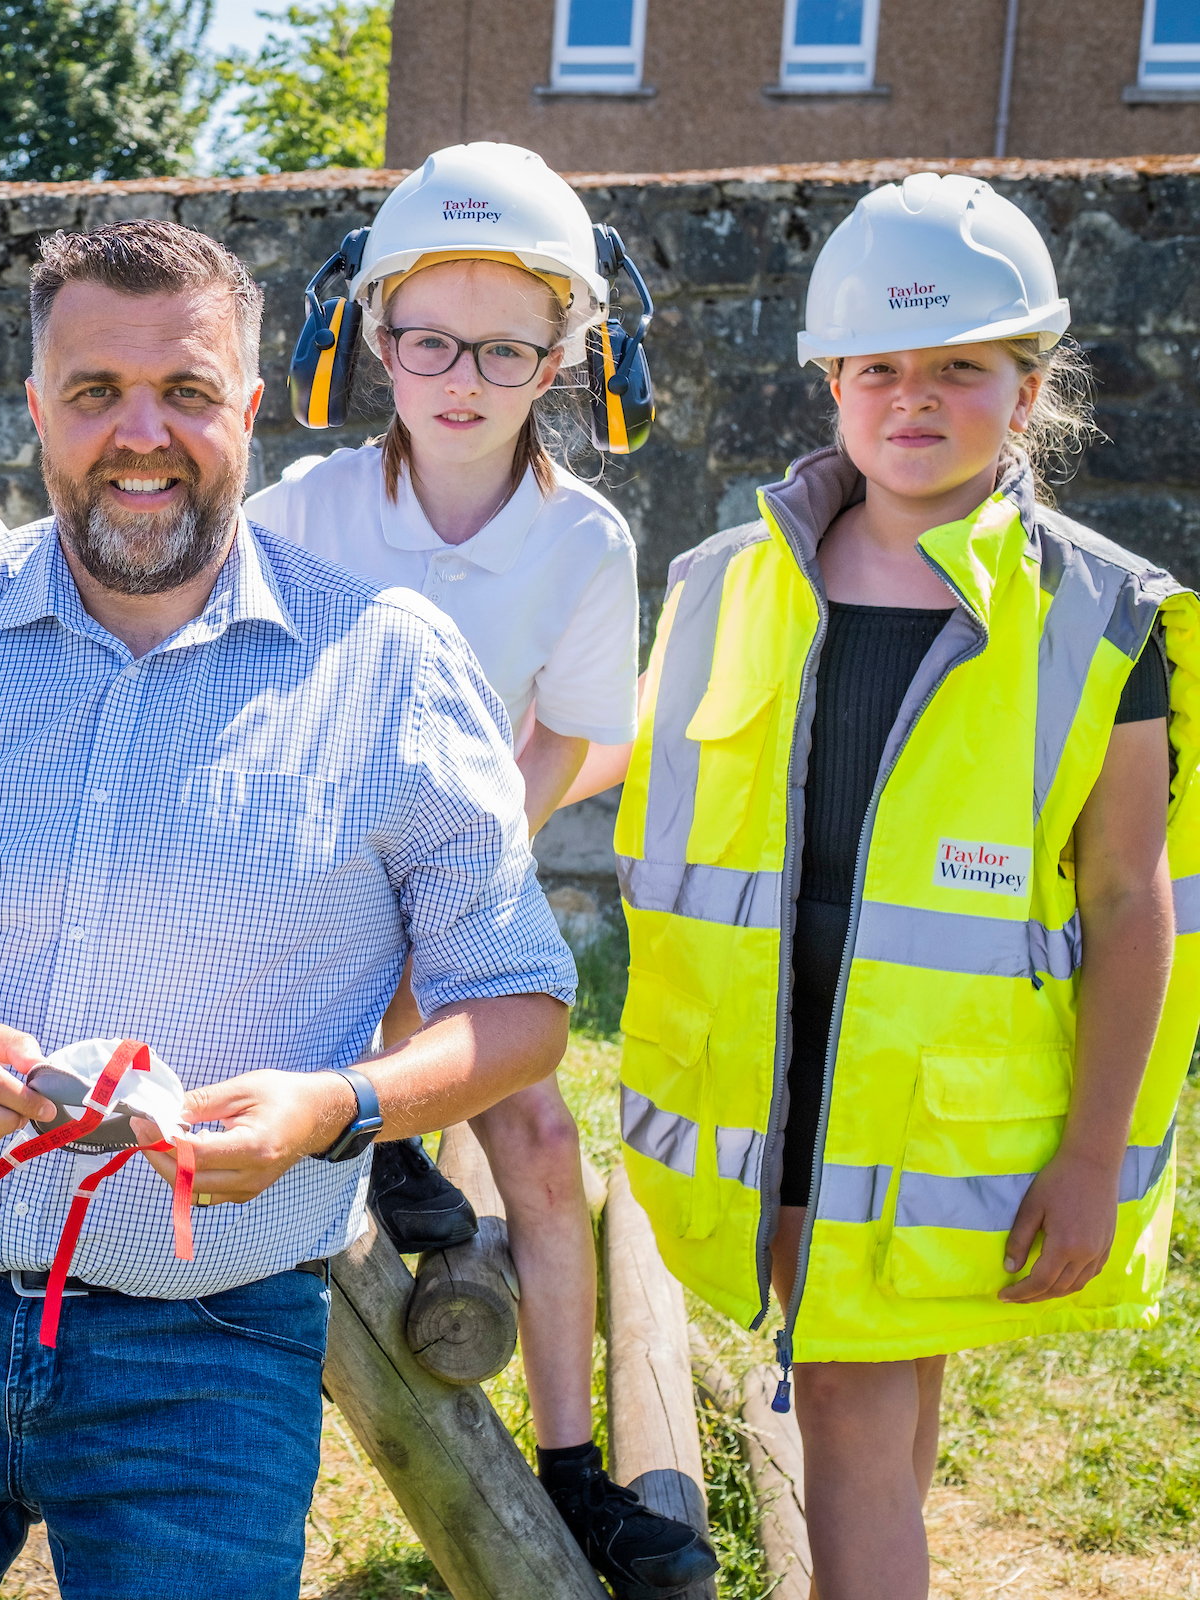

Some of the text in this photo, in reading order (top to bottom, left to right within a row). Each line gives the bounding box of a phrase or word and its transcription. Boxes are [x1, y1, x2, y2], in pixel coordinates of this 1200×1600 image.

[442, 198, 489, 212] Taylor
[442, 210, 502, 223] Wimpey
[887, 282, 936, 299] Taylor
[888, 295, 951, 310] Wimpey
[941, 843, 1009, 868] Taylor
[940, 861, 1026, 892] Wimpey
